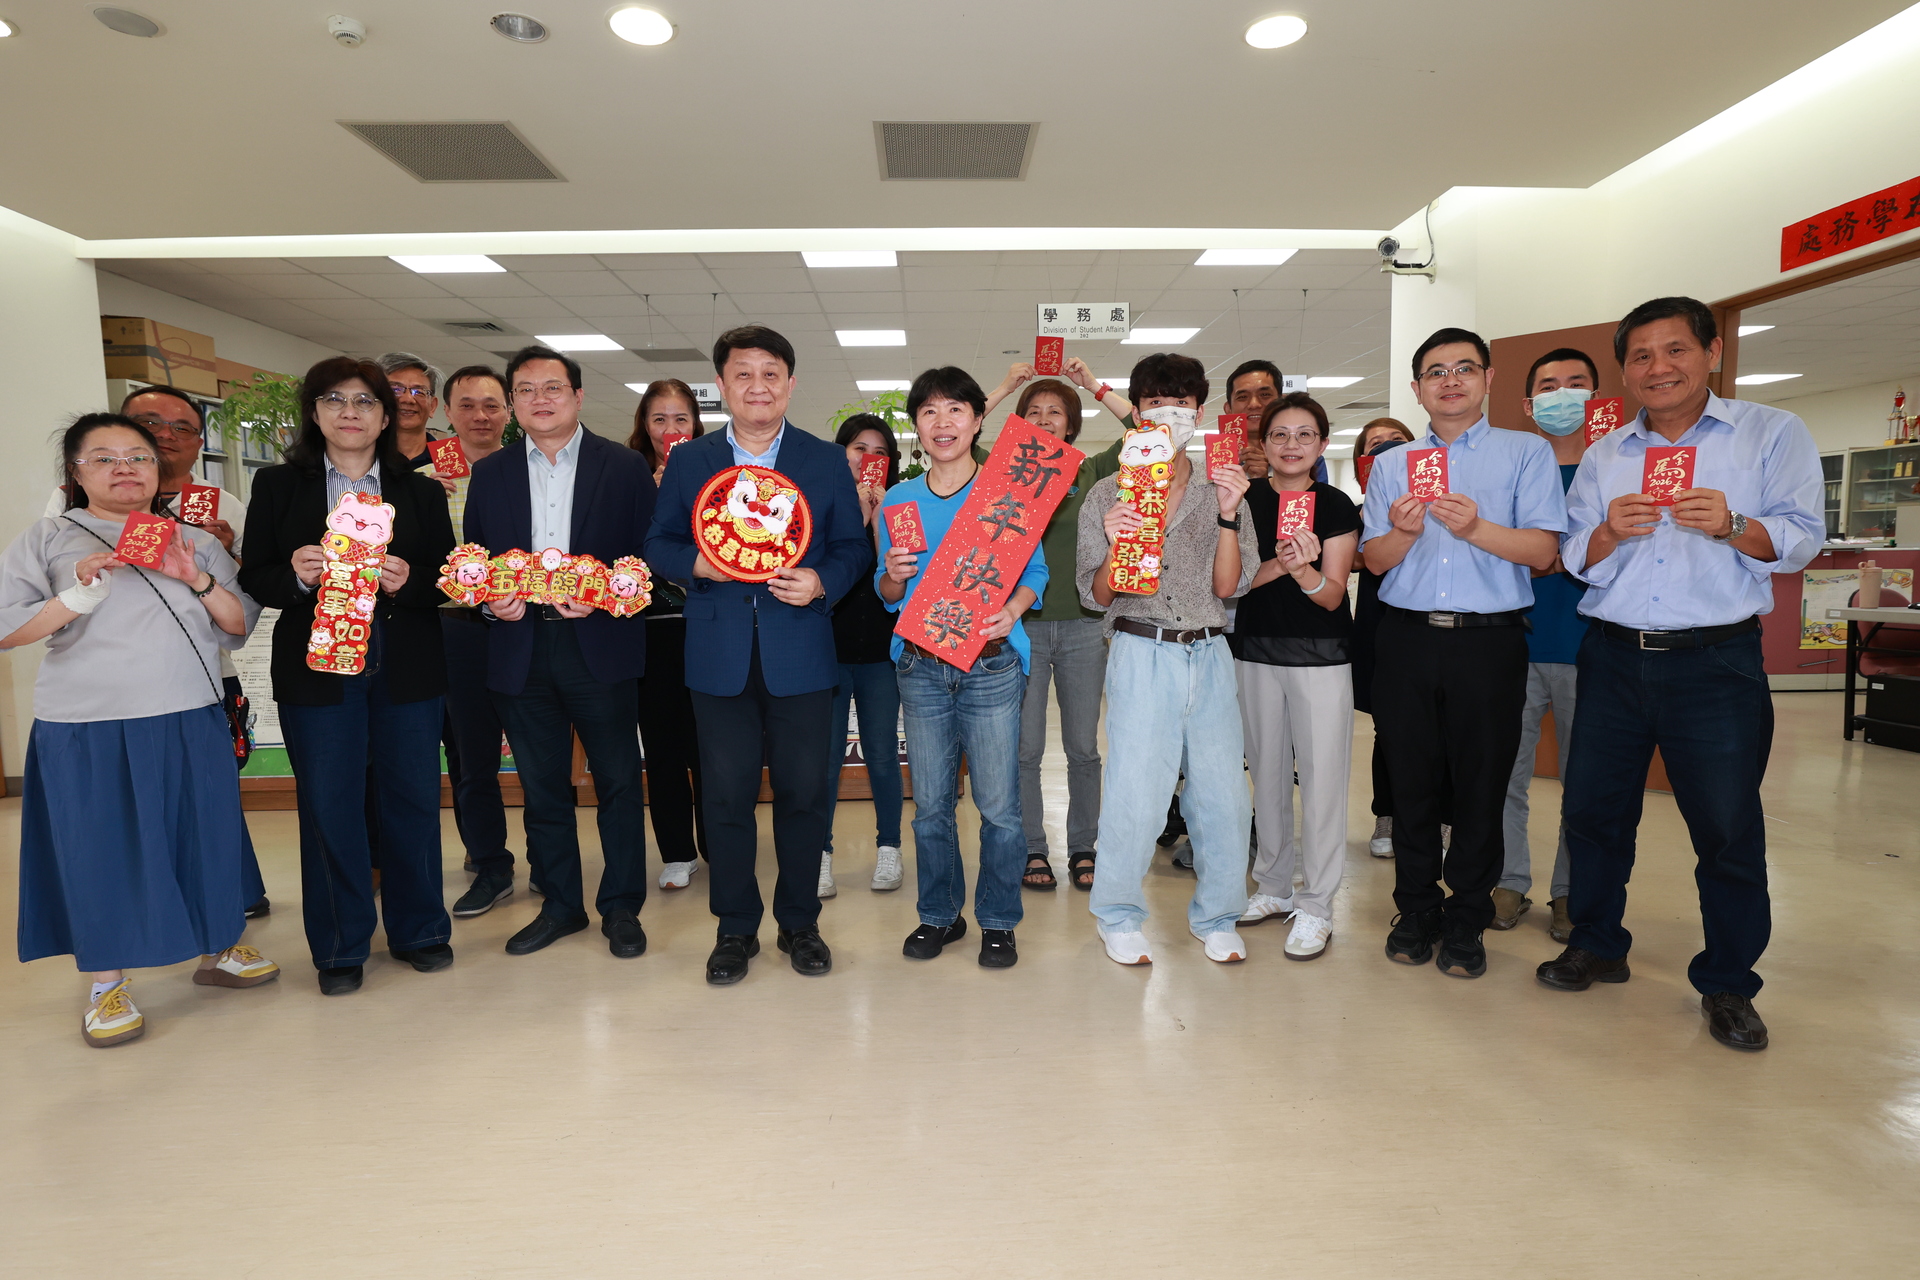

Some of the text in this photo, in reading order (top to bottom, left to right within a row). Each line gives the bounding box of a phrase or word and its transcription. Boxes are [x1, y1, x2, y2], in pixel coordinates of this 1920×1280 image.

[1043, 307, 1125, 323] 學務處
[1043, 325, 1126, 334] Division of Student Affairs
[1590, 422, 1608, 432] 2026
[1413, 476, 1433, 486] 2026
[1649, 476, 1673, 487] 2026
[1283, 515, 1300, 523] 2026
[894, 528, 911, 540] 2026
[1113, 490, 1166, 589] 恭喜發財
[124, 538, 149, 548] 2026
[703, 523, 786, 571] 恭喜發財
[922, 435, 1063, 650] 新年快樂
[489, 569, 607, 602] 五福臨門
[319, 561, 366, 671] 萬事如意
